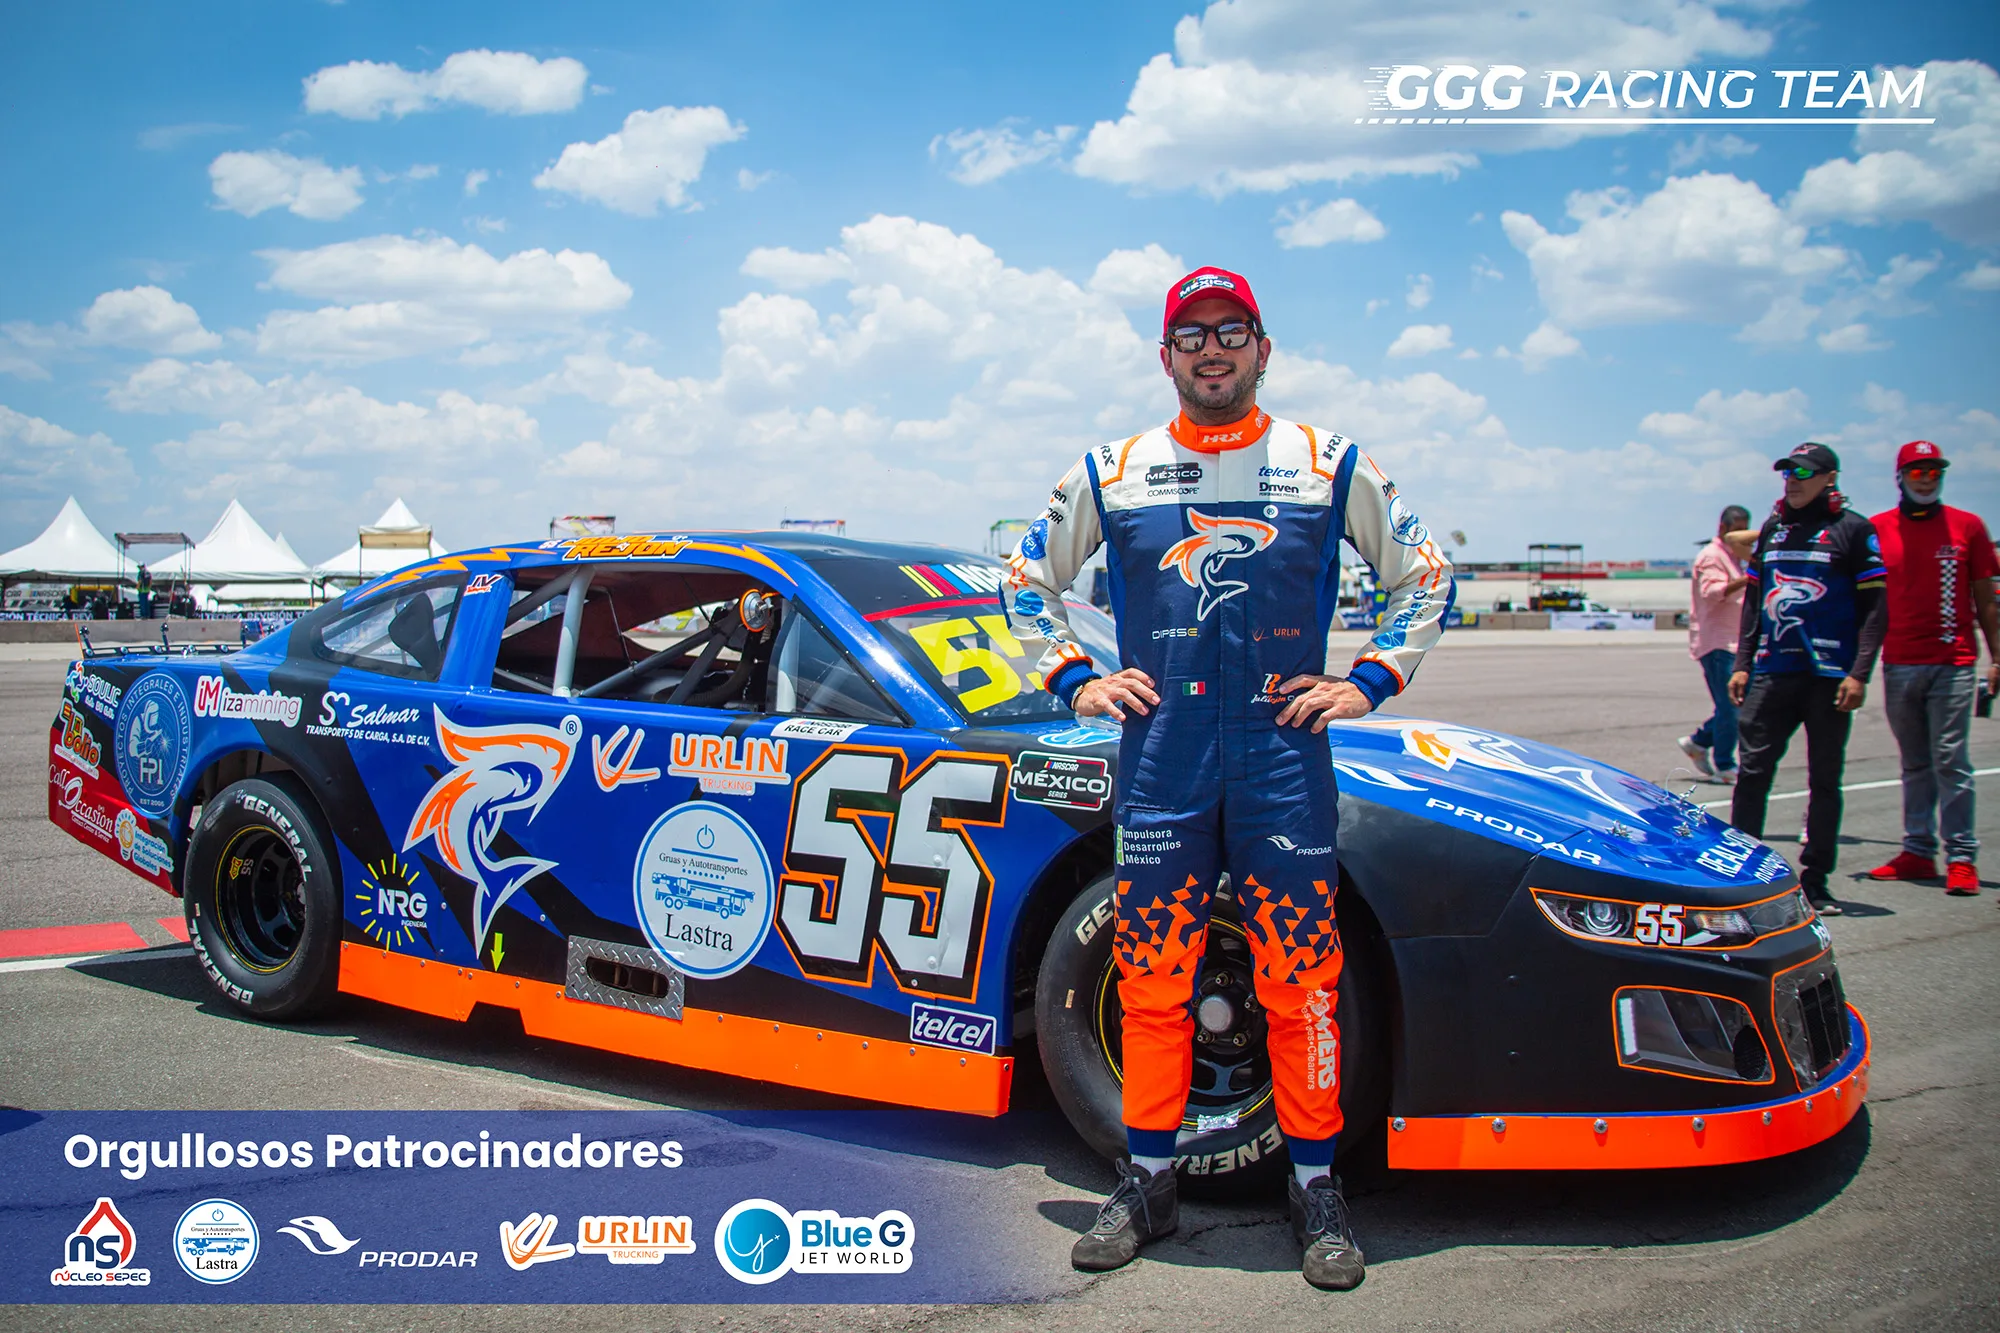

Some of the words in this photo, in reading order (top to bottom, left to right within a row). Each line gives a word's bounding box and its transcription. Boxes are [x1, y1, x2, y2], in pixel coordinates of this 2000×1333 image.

[1202, 431, 1244, 443] HRX
[1323, 433, 1344, 461] HRX
[1147, 470, 1201, 480] MÉXICO
[1258, 465, 1300, 478] telcel
[1259, 482, 1299, 494] Driven
[0, 611, 24, 621] SIÓN
[26, 611, 69, 621] TÉCNICA
[247, 610, 293, 620] REVISIÓN
[1392, 603, 1423, 630] Blue
[1413, 590, 1427, 600] G
[1028, 621, 1039, 634] JET
[1274, 628, 1300, 637] URLIN
[125, 678, 174, 711] INTEGRALES
[174, 691, 181, 701] E
[346, 703, 420, 728] Salmar
[354, 729, 364, 739] DE
[406, 735, 416, 744] DE
[784, 724, 817, 734] RACE
[817, 728, 844, 736] CAR
[673, 736, 785, 774] URLIN
[1052, 761, 1079, 772] NASCAR
[703, 777, 752, 792] TRUCKING
[1013, 769, 1106, 794] MÉXICO
[1048, 790, 1068, 799] SERIES
[243, 796, 312, 882] GENERAL
[1123, 828, 1172, 839] Impulsora
[1425, 797, 1602, 866] PRODAR
[1124, 840, 1181, 852] Desarrollos
[1297, 846, 1332, 856] PRODAR
[659, 852, 681, 865] Gruas
[682, 859, 688, 867] y
[689, 858, 749, 877] Autotransportes
[781, 753, 998, 978] 55
[1125, 853, 1161, 865] México
[378, 888, 428, 919] NRG
[1636, 904, 1683, 943] 55
[664, 912, 733, 951] Lastra
[190, 919, 253, 1004] GENERAL
[914, 1010, 991, 1048] telcel
[1175, 1122, 1284, 1175] ENER
